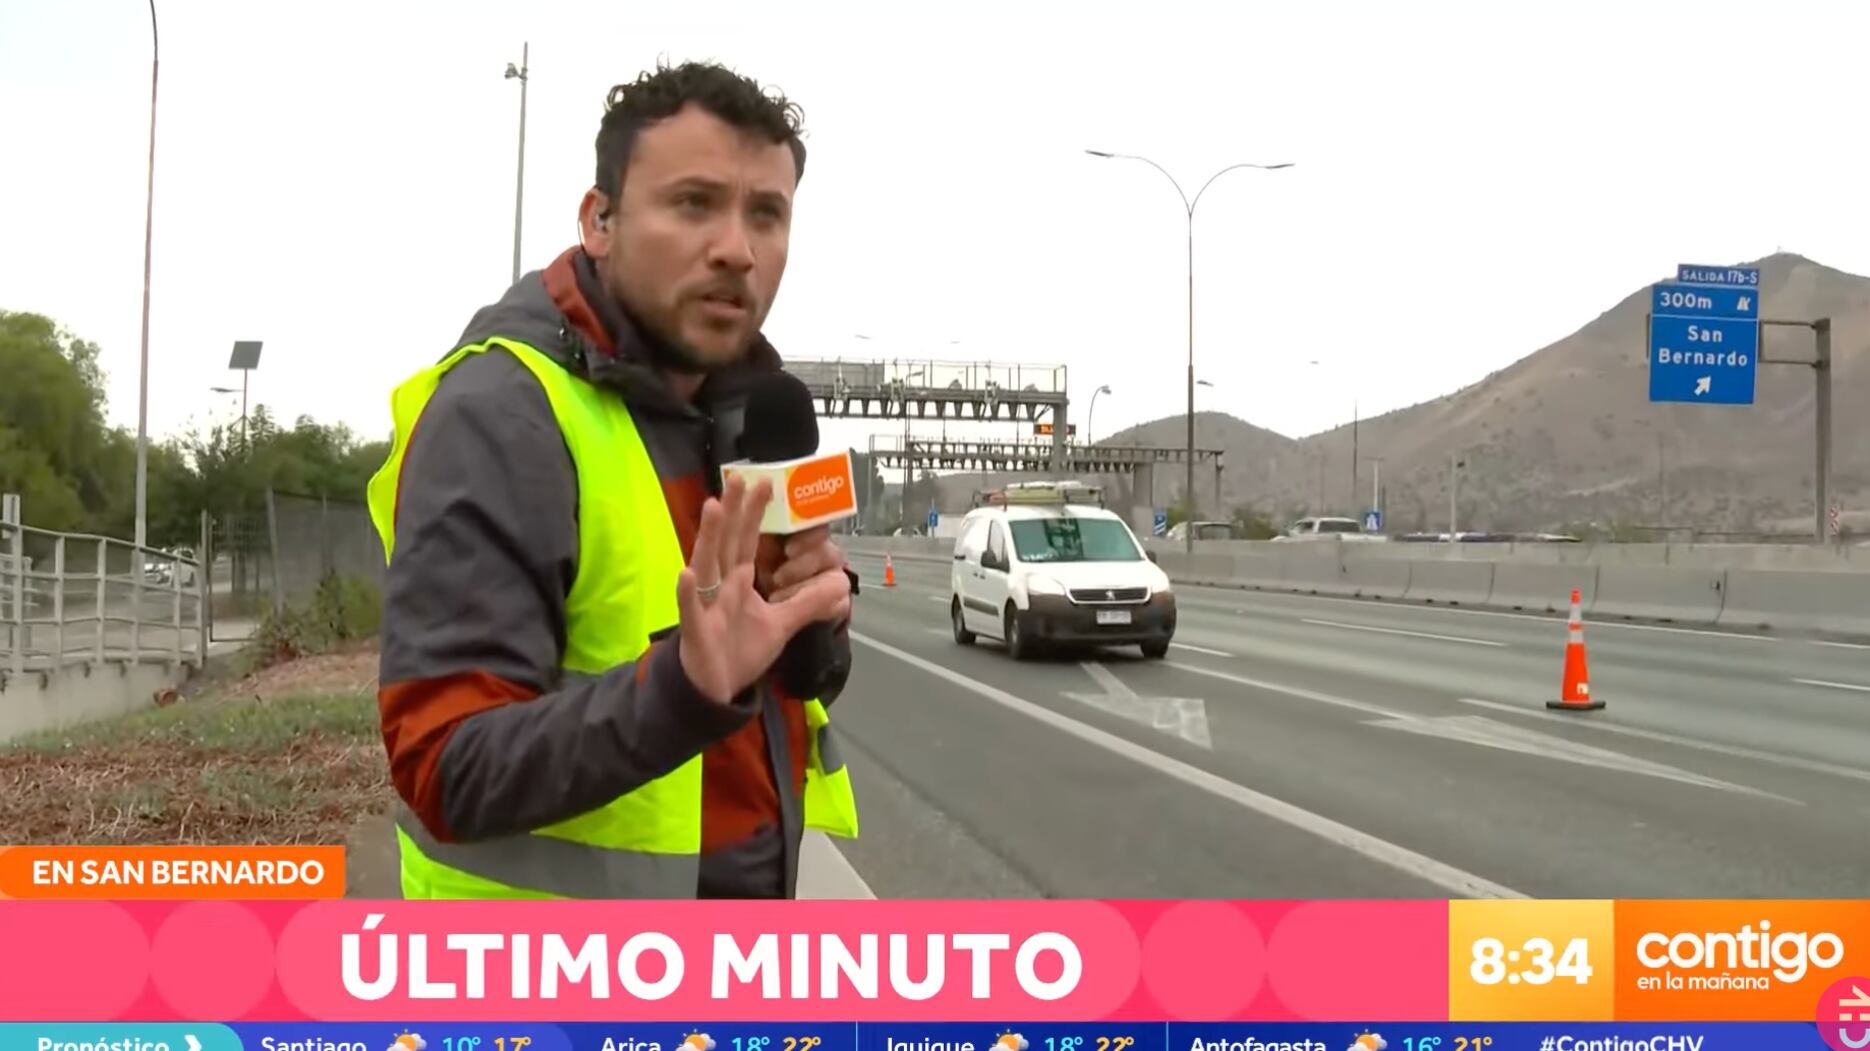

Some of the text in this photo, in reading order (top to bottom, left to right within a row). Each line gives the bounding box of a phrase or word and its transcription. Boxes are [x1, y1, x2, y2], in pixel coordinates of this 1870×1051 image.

[1681, 269, 1758, 284] SALIDA 17b-S
[1660, 292, 1712, 310] 300m
[1687, 325, 1723, 343] San
[1658, 347, 1748, 367] Bernardo
[794, 475, 844, 499] contigo
